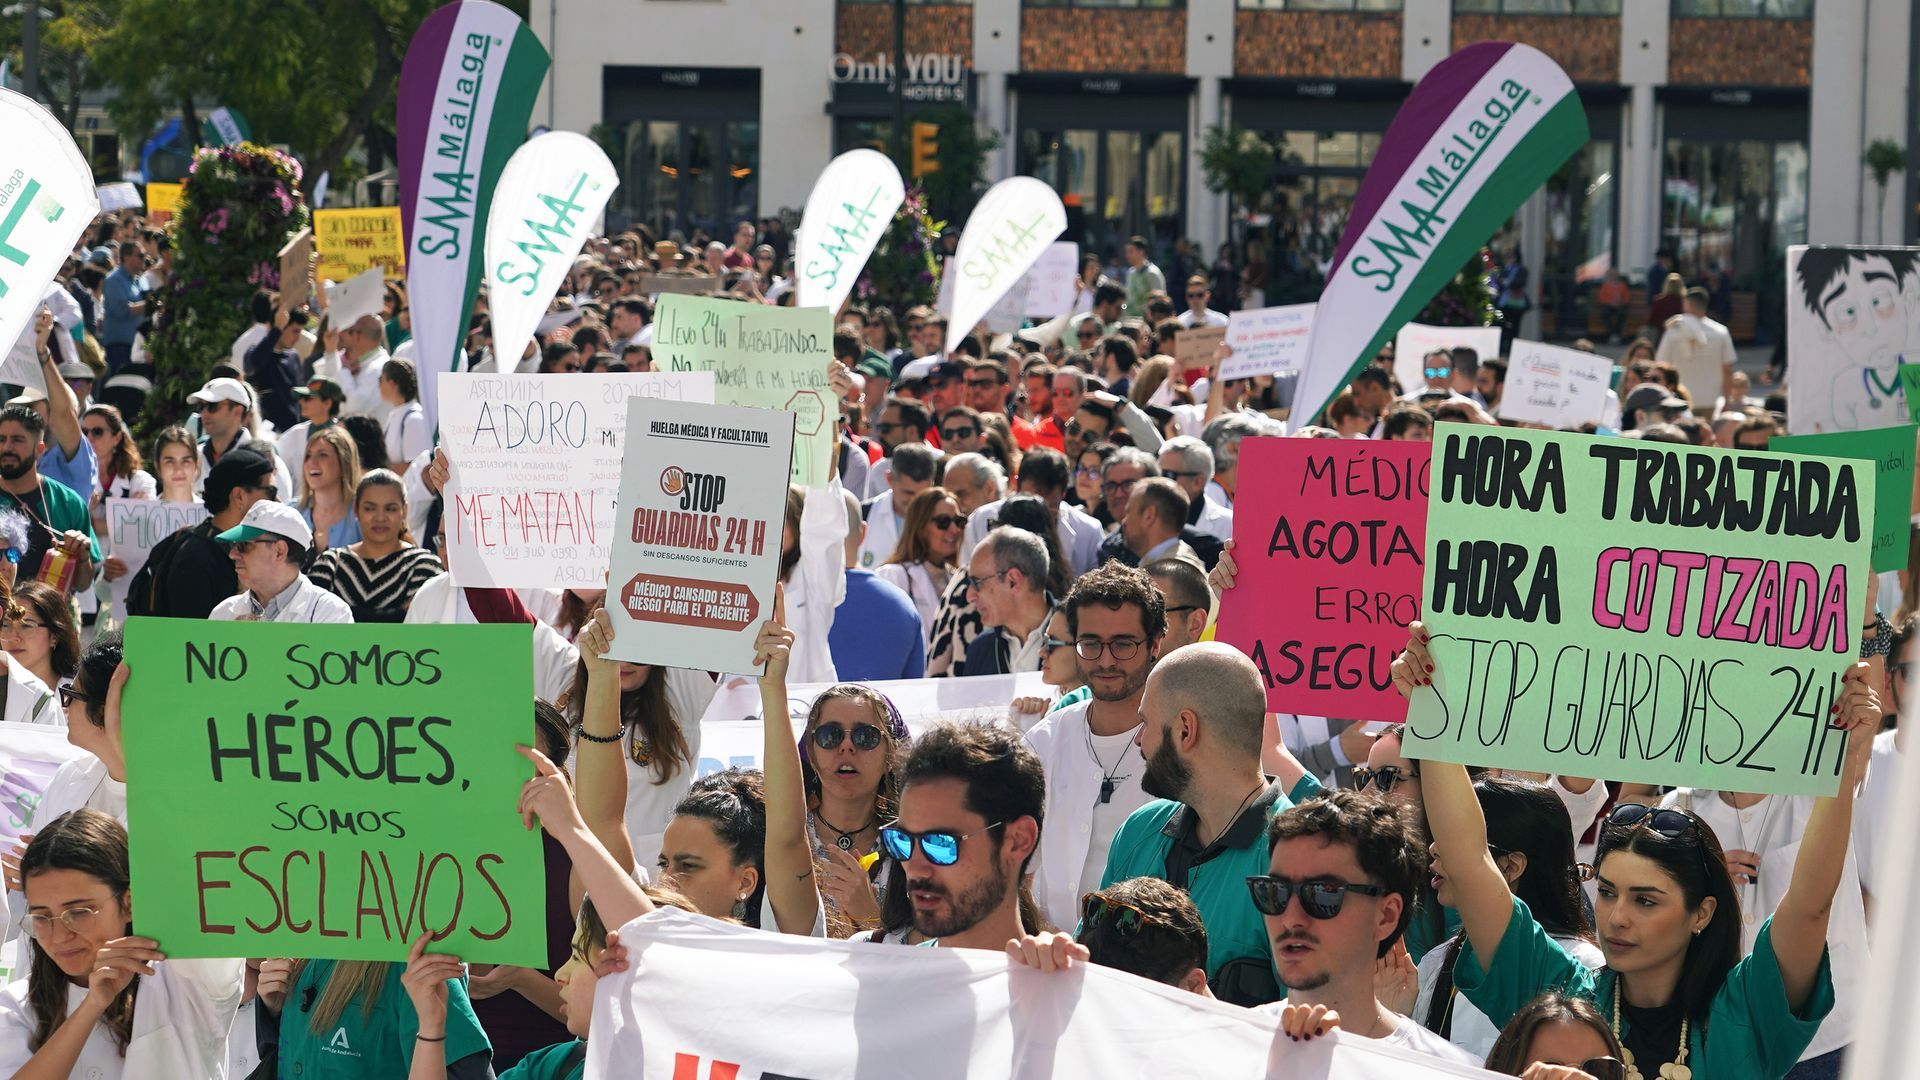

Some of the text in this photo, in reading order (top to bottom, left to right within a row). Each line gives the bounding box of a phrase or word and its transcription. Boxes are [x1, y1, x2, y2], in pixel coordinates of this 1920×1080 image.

[438, 31, 490, 160] Málaga
[828, 52, 962, 92] Only YOU
[904, 86, 964, 100] HOTELS
[1416, 77, 1526, 199] Málaga
[756, 371, 765, 388] A
[472, 400, 587, 449] ADORO
[650, 421, 768, 444] HUELGA MÉDICA Y FACULTATIVA
[680, 472, 726, 513] STOP
[1441, 434, 1861, 543] HORA TRABAJADA
[456, 490, 595, 547] ME MATAN
[631, 507, 766, 556] GUARDIAS 24 H
[643, 550, 748, 568] SIN DESCANSOS SUFICIENTES
[628, 596, 750, 623] RIESGO PARA EL PACIENTE
[634, 580, 748, 607] MÉDICO CANSADO ES UN
[1315, 587, 1423, 628] ERRO
[1432, 539, 1850, 654] HORA COTIZADA
[185, 641, 442, 690] NO SOMOS
[1411, 633, 1849, 776] STOP GUARDIAS 24H
[207, 699, 471, 792] HÉROES,
[271, 802, 406, 839] SOMOS
[193, 845, 513, 944] ESCLAVOS
